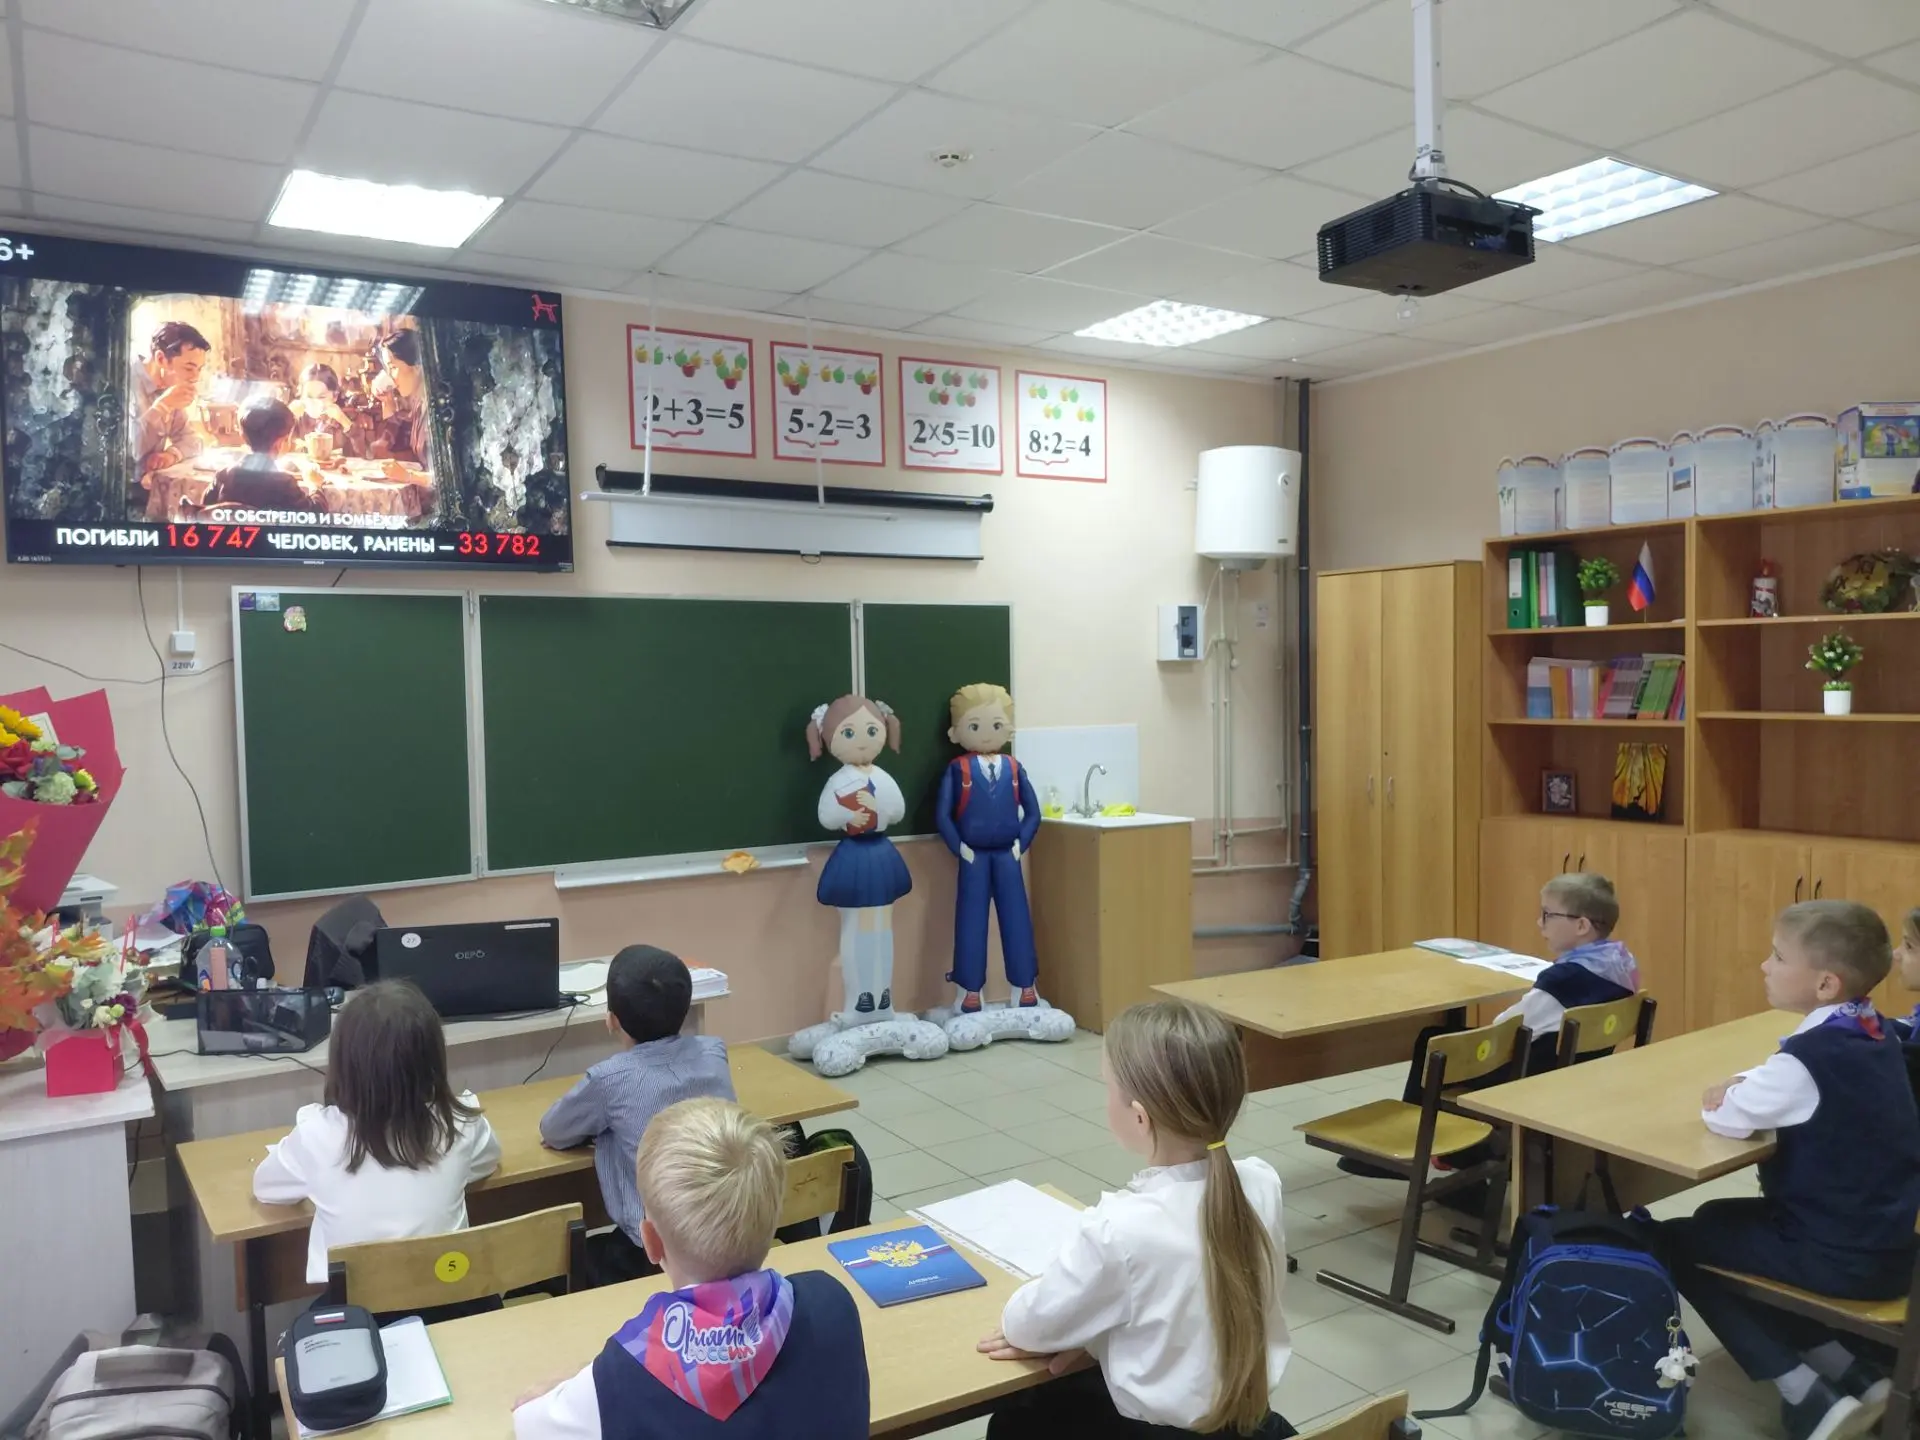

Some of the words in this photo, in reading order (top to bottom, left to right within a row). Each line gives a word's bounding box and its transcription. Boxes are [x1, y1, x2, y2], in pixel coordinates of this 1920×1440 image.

[0, 237, 35, 262] 6+
[643, 394, 745, 429] 2+3=5
[787, 407, 872, 440] 5-2=3
[1028, 429, 1092, 457] 8:2=4
[211, 508, 231, 523] ОТ
[233, 509, 317, 526] ОБСТРЕЛОВ
[319, 513, 331, 526] И
[56, 527, 160, 547] ПОГИБЛИ
[166, 524, 200, 548] 16
[207, 526, 261, 549] 747
[267, 533, 359, 555] ЧЕЛОВЕК,
[363, 536, 435, 553] РАНЕНЫ
[458, 533, 489, 554] 33
[496, 534, 541, 556] 782
[448, 1260, 457, 1272] 5
